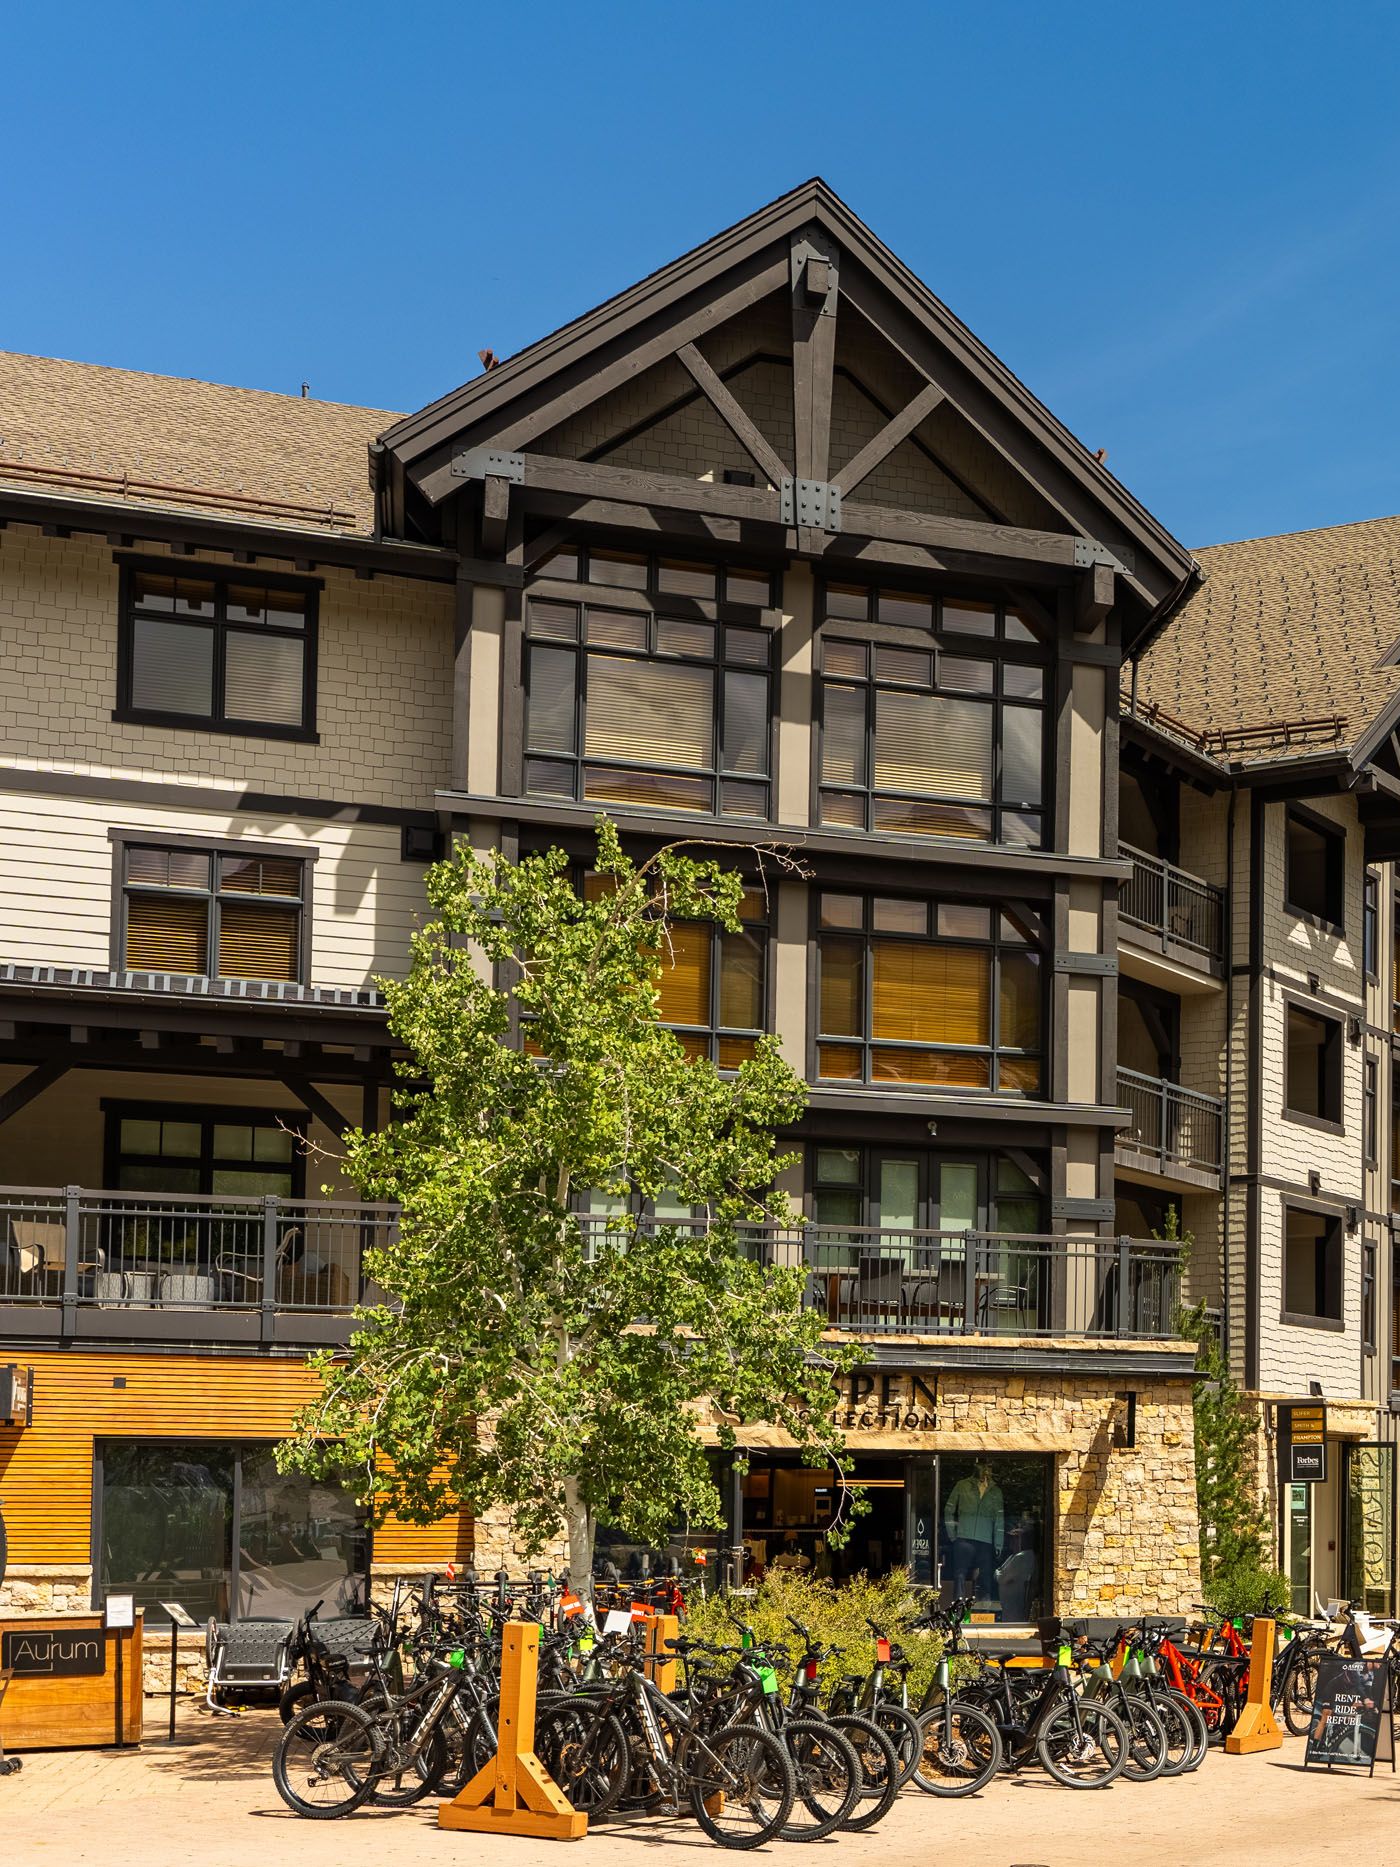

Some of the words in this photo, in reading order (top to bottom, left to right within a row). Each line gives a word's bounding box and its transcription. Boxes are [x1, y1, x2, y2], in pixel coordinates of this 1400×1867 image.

[1296, 1456, 1320, 1465] Forbes
[15, 1640, 98, 1662] Aurum
[410, 1682, 456, 1743] TREK
[1334, 1705, 1358, 1715] RIDE.
[635, 1692, 664, 1762] TREK
